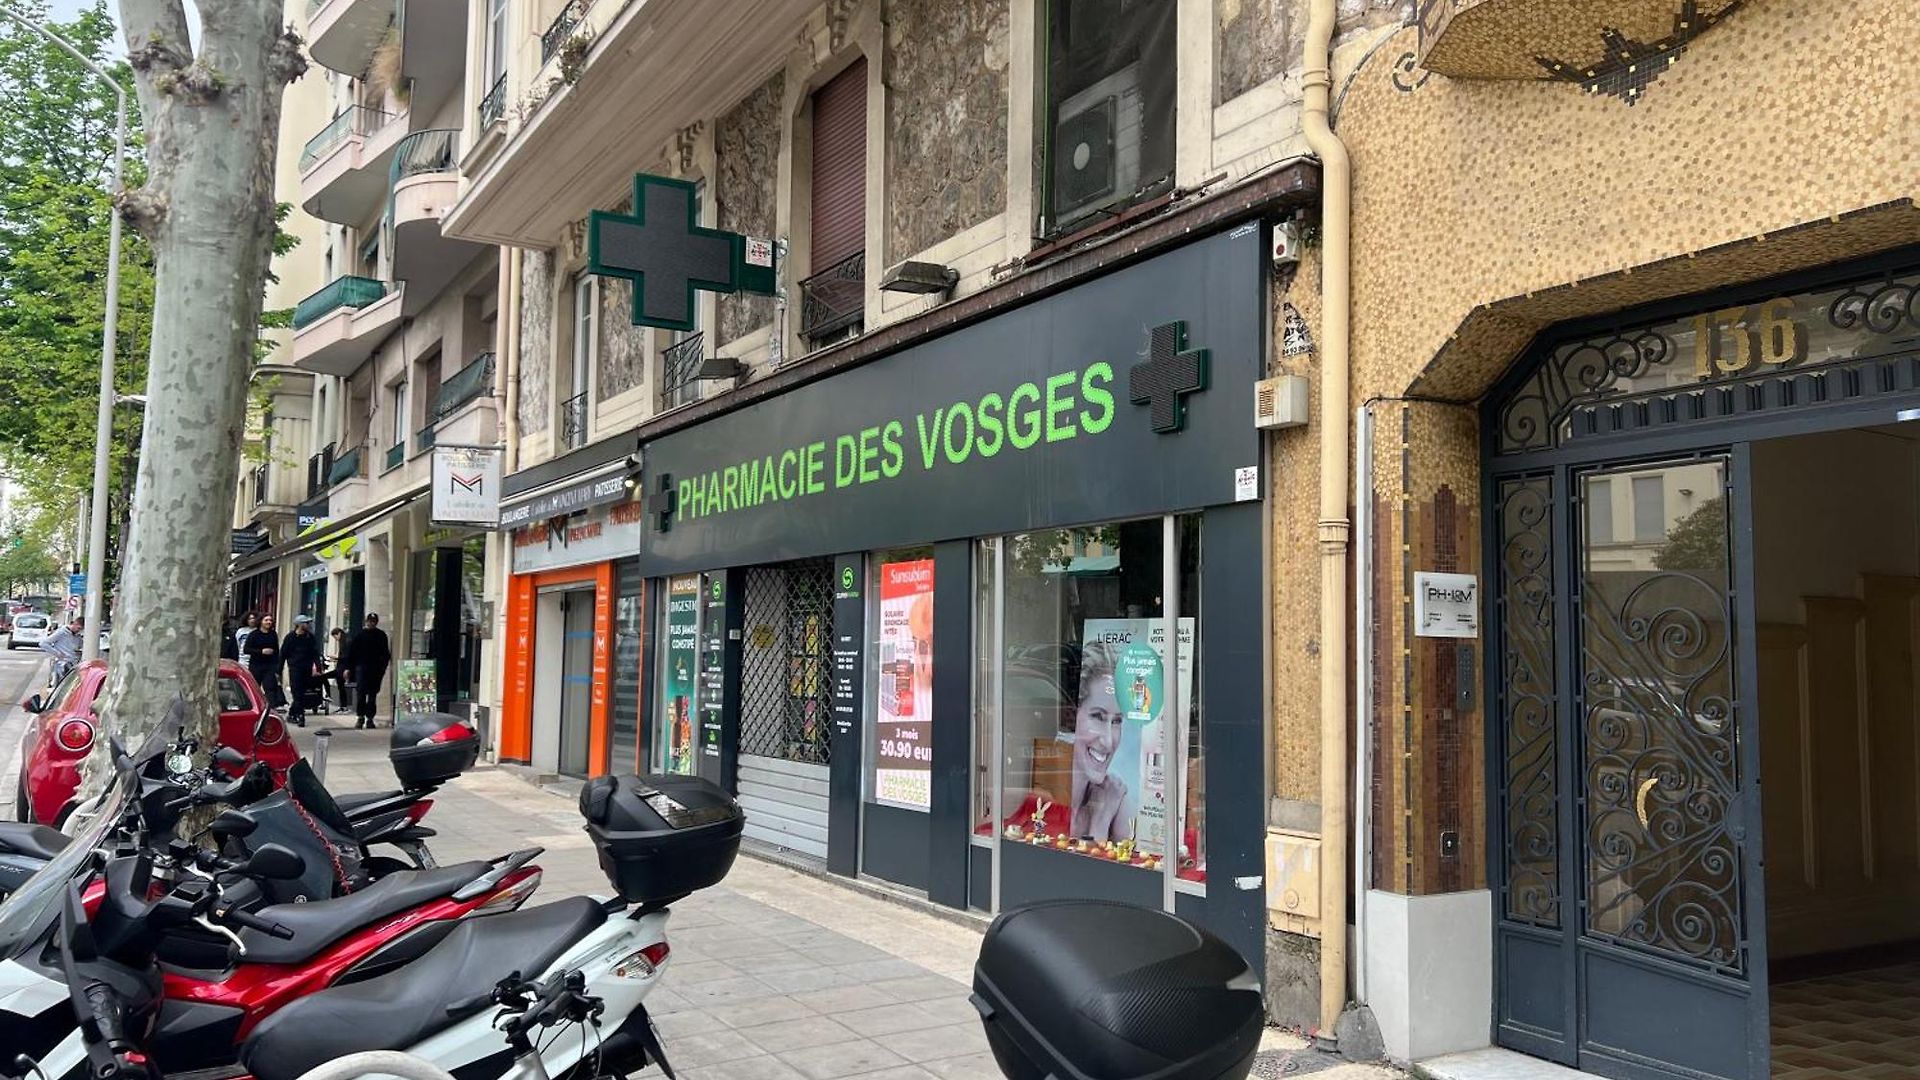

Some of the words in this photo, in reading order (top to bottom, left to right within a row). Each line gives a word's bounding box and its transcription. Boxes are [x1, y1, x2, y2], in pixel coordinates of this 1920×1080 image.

[1691, 297, 1796, 377] 136
[678, 441, 827, 521] PHARMACIE
[835, 420, 906, 488] DES
[916, 361, 1116, 470] VOSGES
[1097, 632, 1132, 644] LIERAC
[895, 727, 901, 738] 3
[902, 729, 919, 740] mois
[880, 739, 912, 759] 30.90
